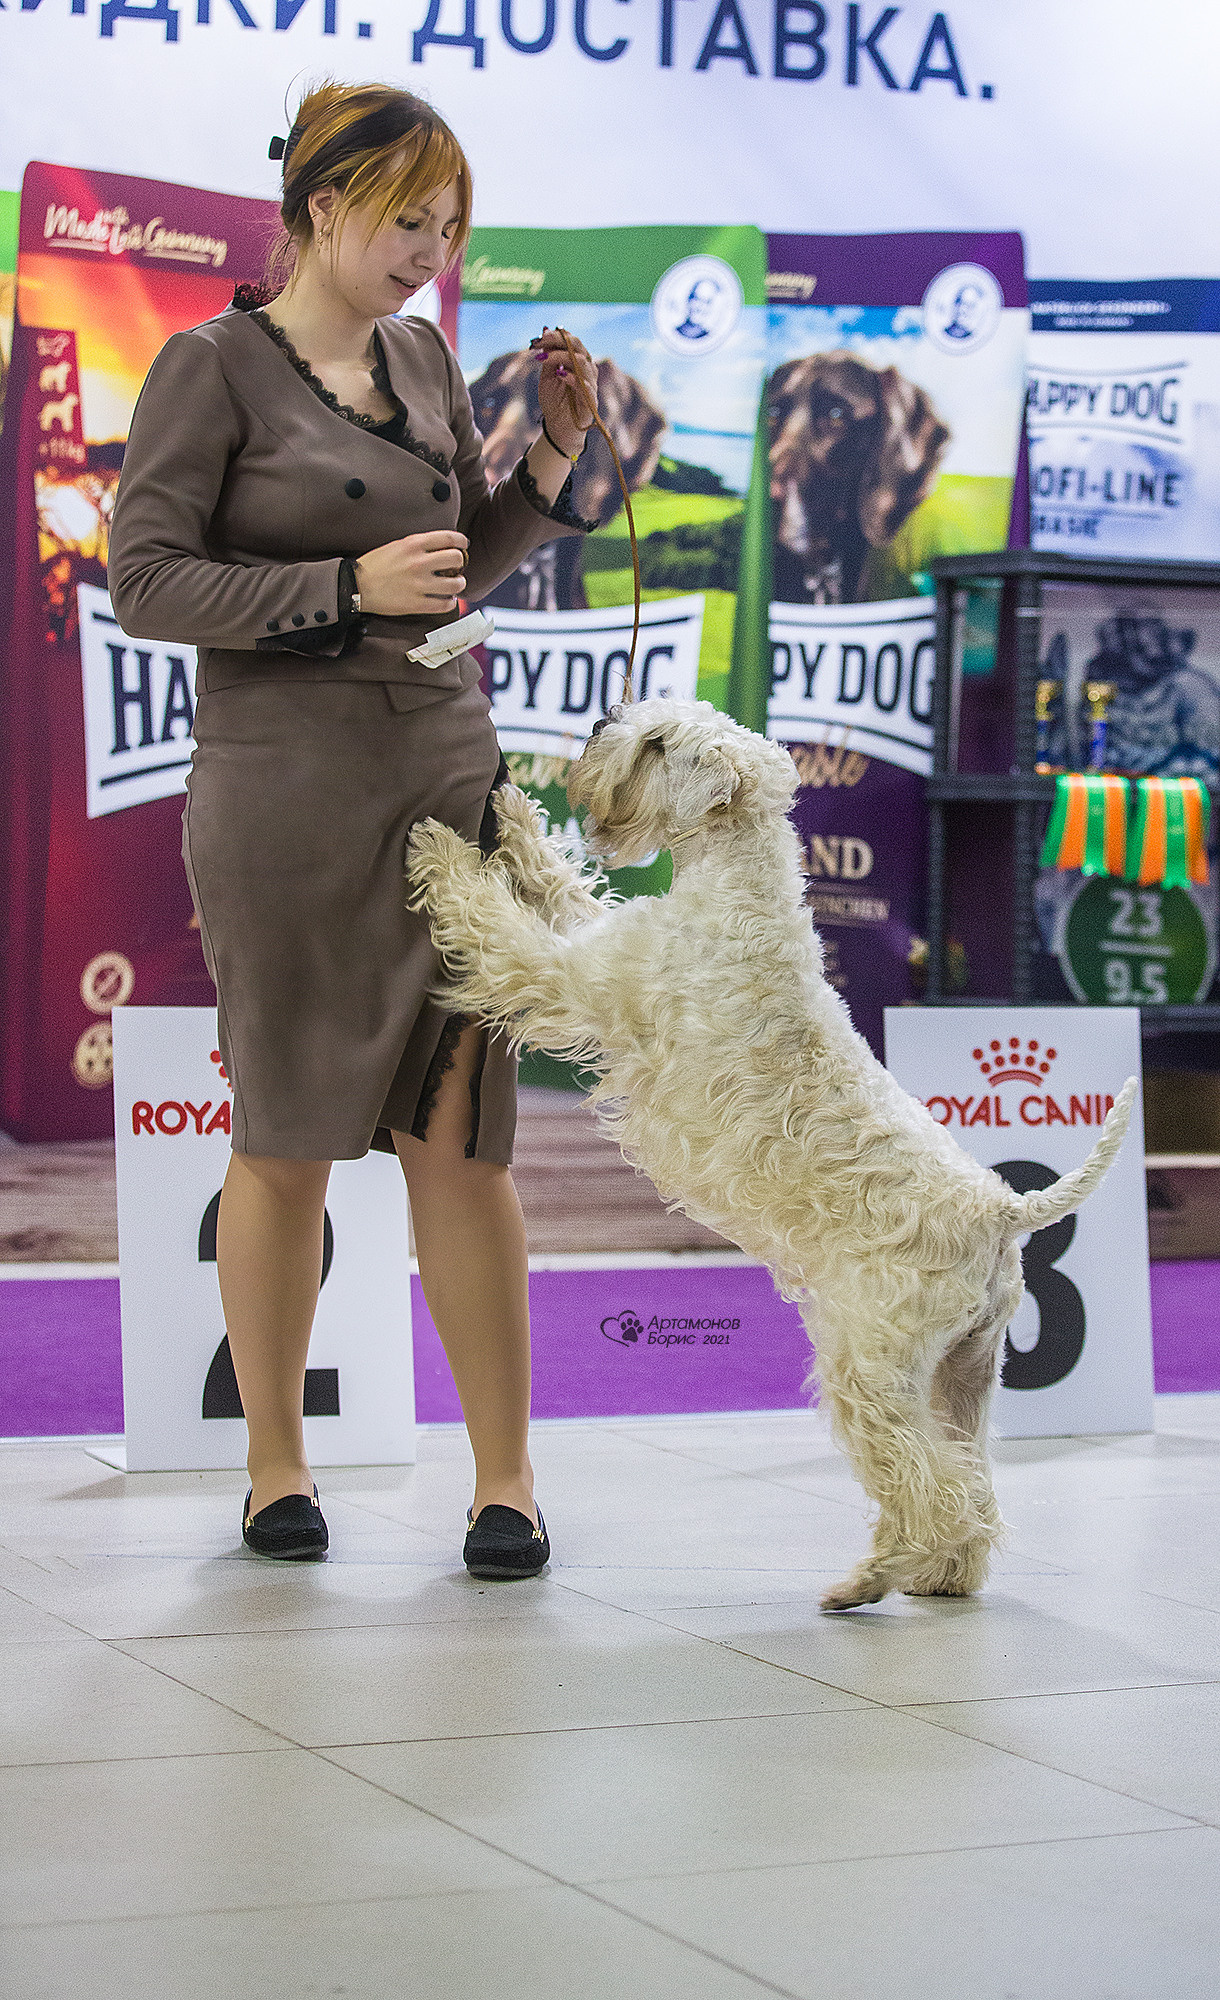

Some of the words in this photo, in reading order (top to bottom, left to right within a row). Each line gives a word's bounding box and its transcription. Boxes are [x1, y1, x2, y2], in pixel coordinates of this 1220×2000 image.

[1109, 377, 1180, 426] DOG
[1032, 465, 1182, 508] OFI-LINE
[105, 642, 195, 756] HA
[486, 648, 550, 709] PY
[770, 641, 826, 699] PY
[836, 638, 936, 726] DOG
[1109, 888, 1162, 936] 23
[131, 1100, 232, 1136] ROYA
[919, 1095, 1012, 1127] OYAL
